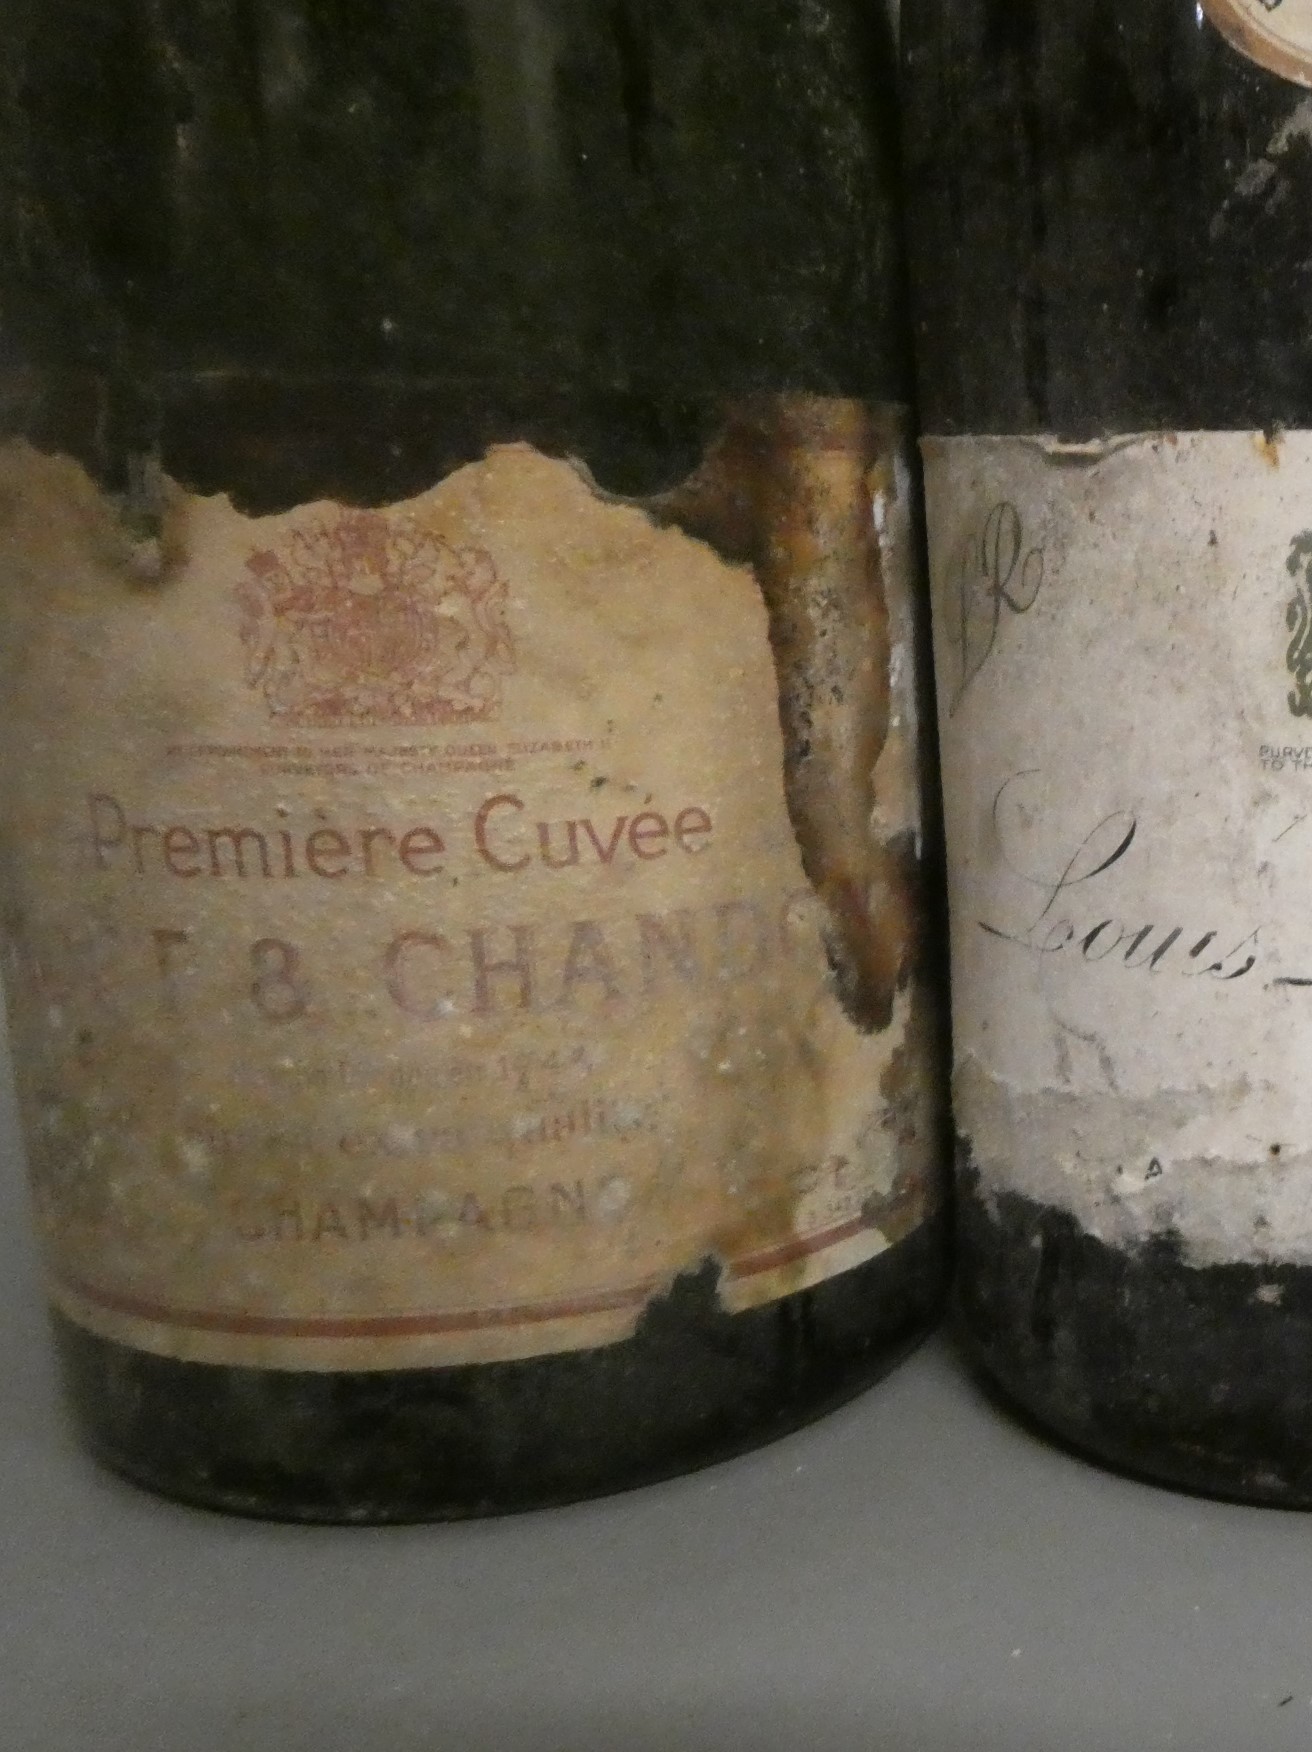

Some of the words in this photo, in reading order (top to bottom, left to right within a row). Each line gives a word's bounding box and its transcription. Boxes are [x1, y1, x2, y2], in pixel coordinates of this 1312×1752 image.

[1261, 759, 1285, 772] TO
[91, 791, 446, 880] Première
[474, 791, 713, 873] Cuvée
